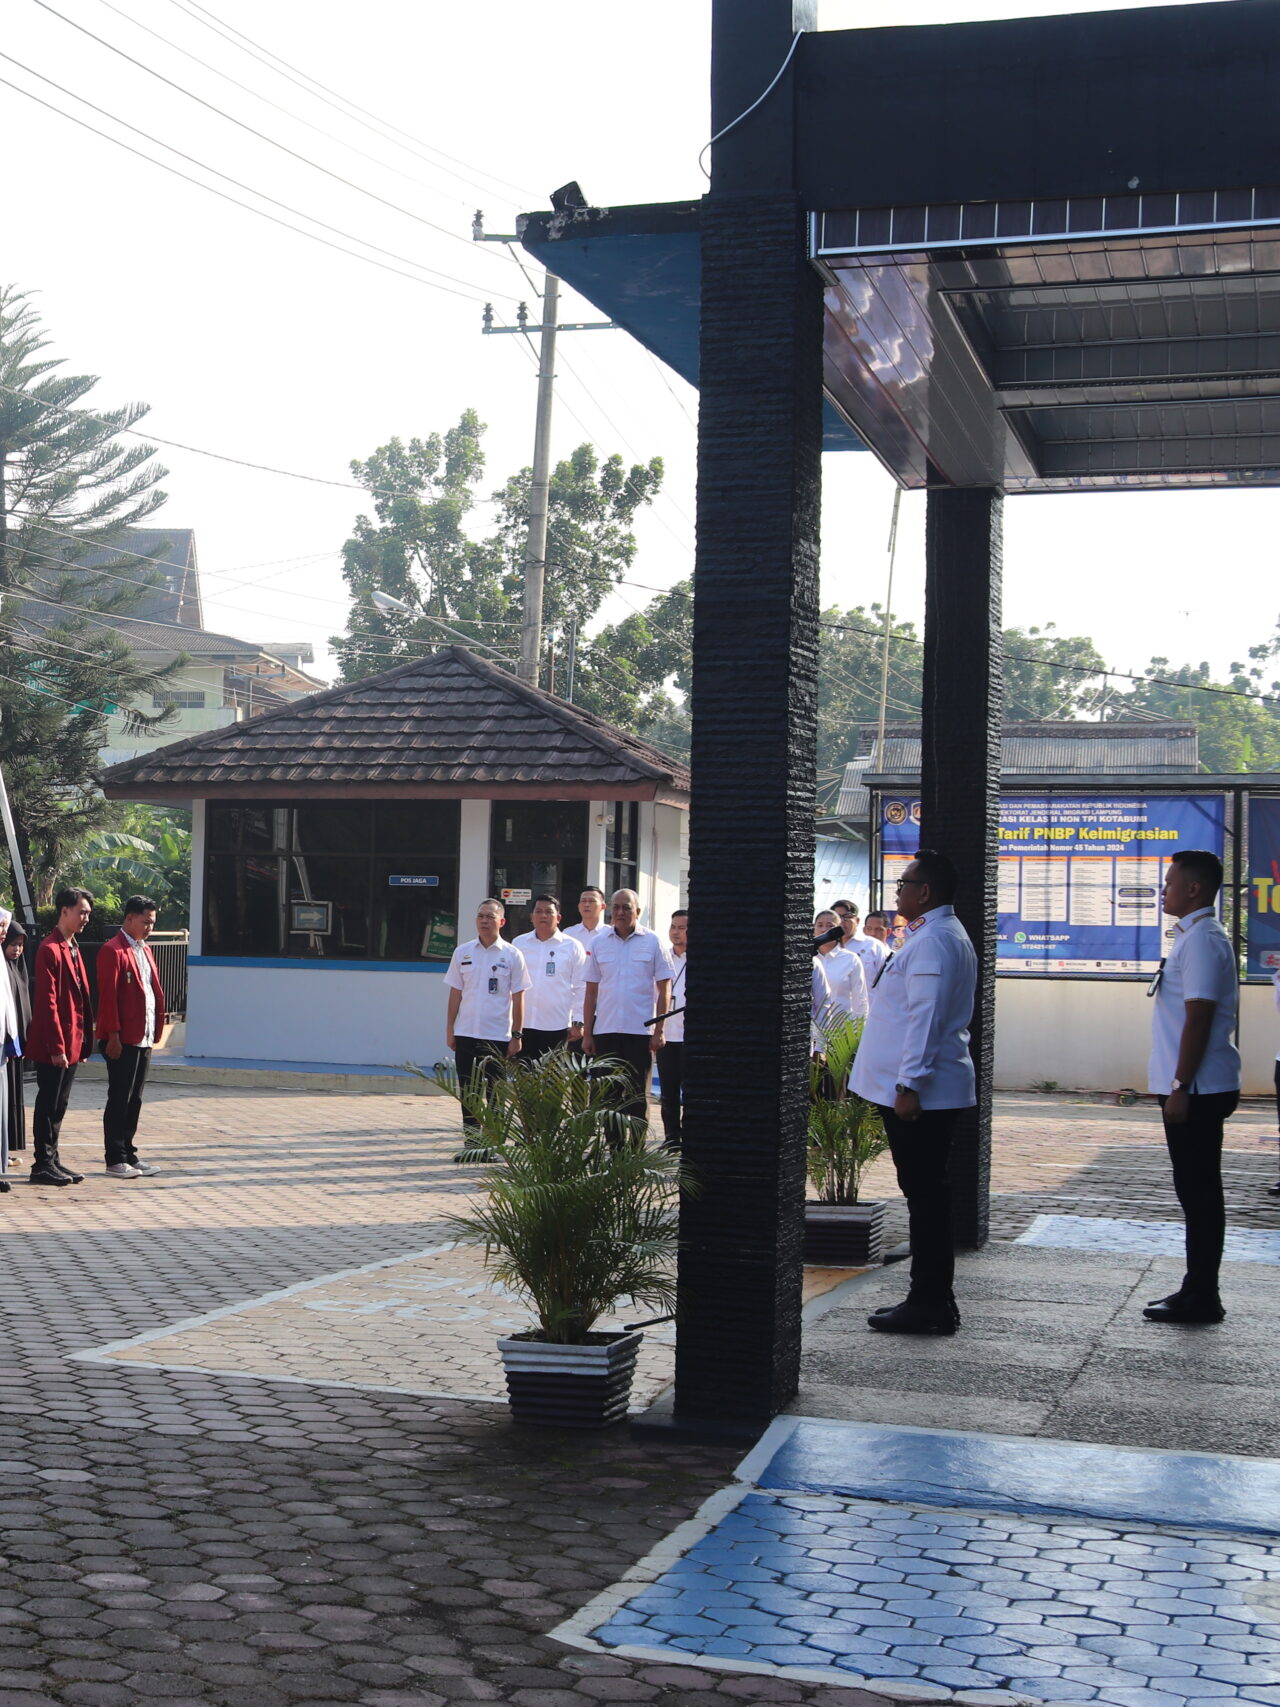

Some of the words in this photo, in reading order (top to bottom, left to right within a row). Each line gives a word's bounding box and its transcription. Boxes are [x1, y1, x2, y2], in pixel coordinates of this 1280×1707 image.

[997, 827, 1031, 840] Tarif
[1033, 827, 1076, 840] PNBP
[1078, 827, 1179, 843] Keimigrasian
